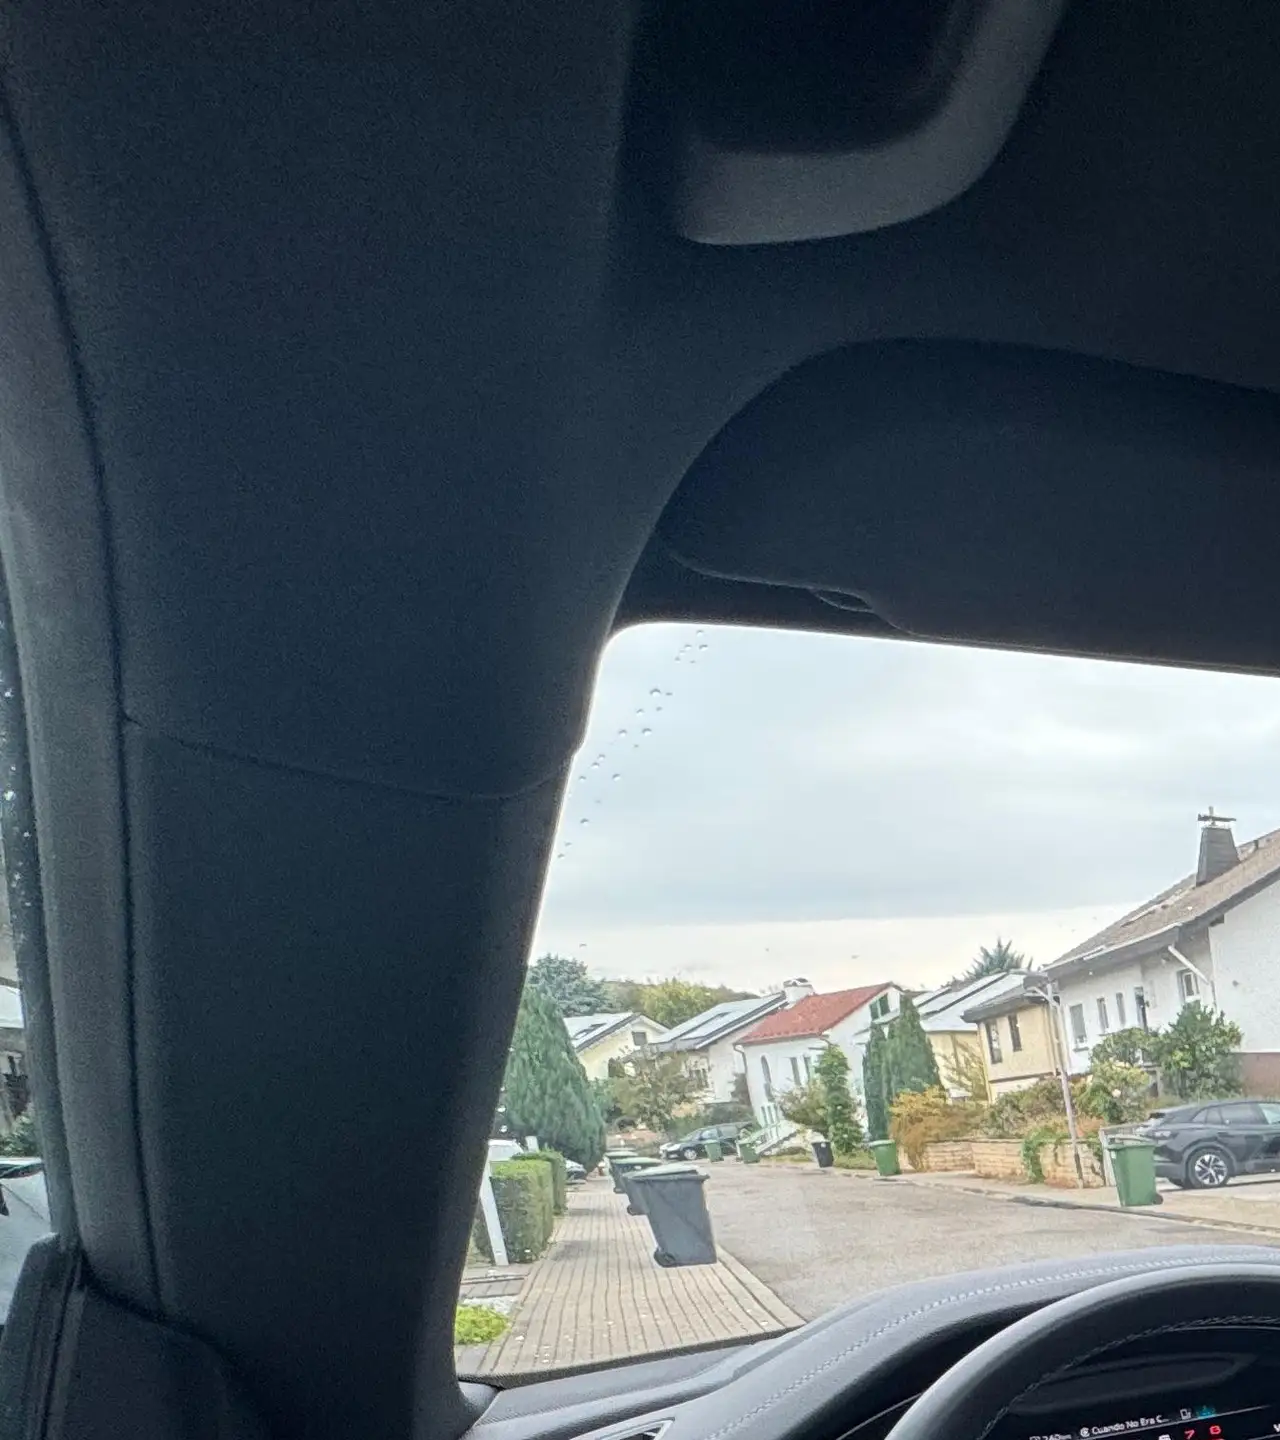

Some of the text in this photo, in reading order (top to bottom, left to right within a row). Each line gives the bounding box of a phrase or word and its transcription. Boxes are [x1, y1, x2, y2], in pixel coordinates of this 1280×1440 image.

[1091, 1422, 1125, 1435] Cuando
[1125, 1420, 1139, 1429] No
[1140, 1417, 1155, 1427] Era
[1184, 1429, 1195, 1440] 7
